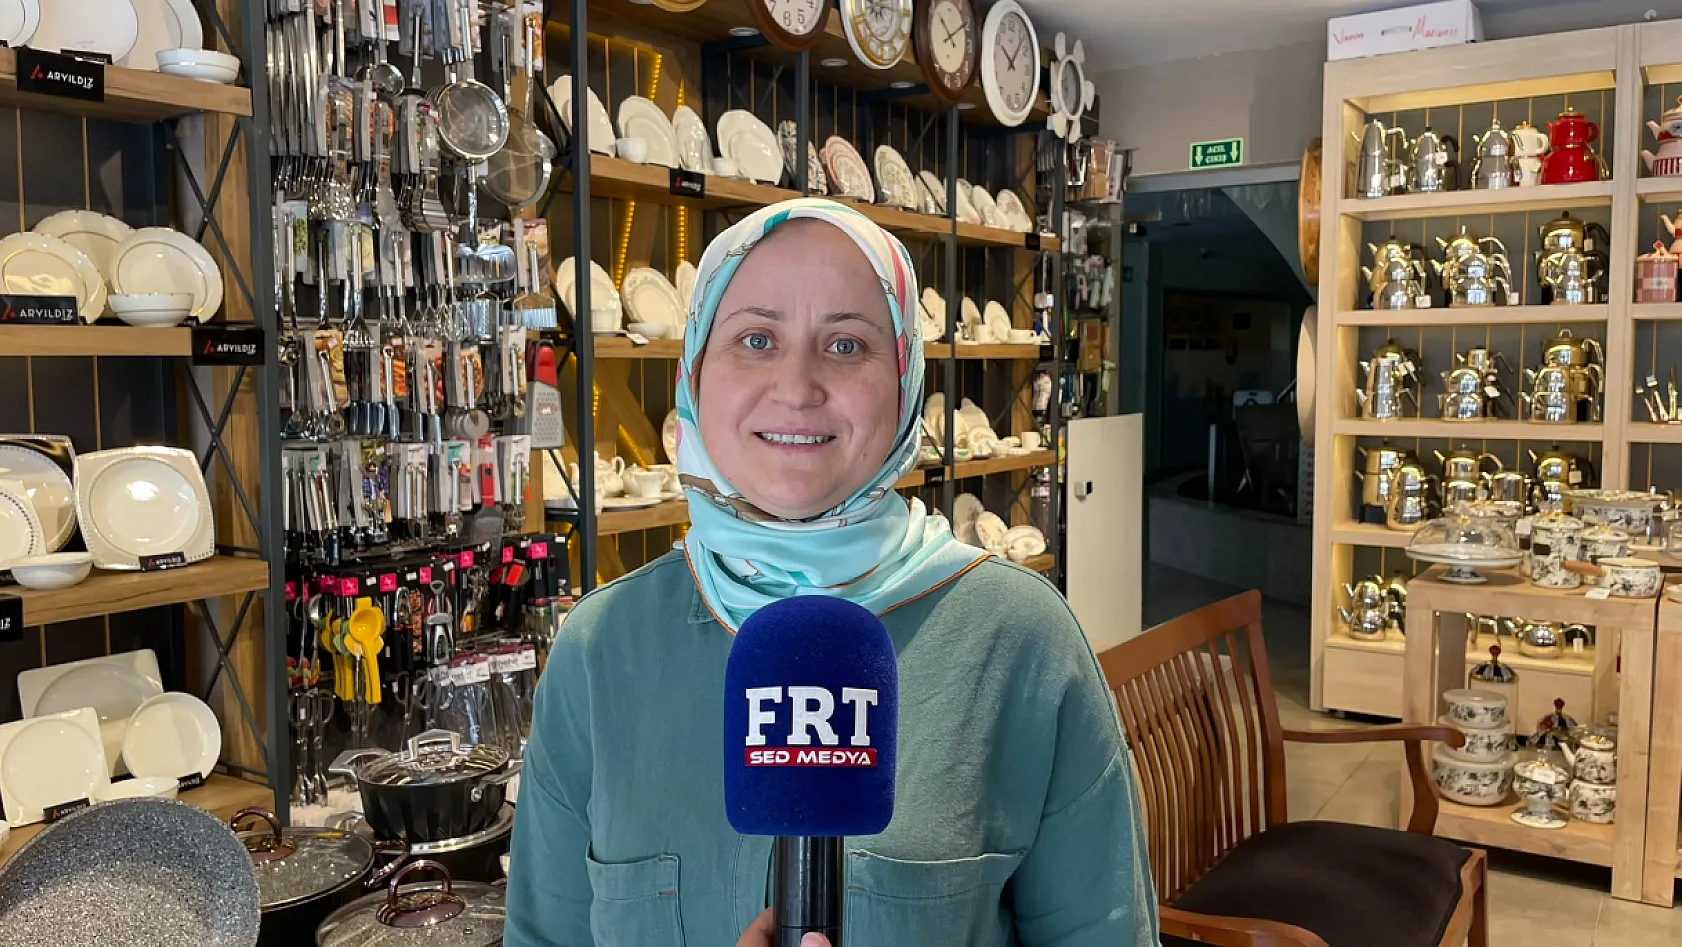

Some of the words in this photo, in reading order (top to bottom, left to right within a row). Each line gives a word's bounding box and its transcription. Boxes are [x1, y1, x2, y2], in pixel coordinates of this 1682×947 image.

[783, 11, 792, 26] 6
[797, 8, 805, 24] 5
[46, 70, 94, 88] ARYILDIZ
[20, 308, 73, 321] ARYILDIZ
[216, 344, 257, 356] ARYILDIZ
[745, 686, 878, 747] FRT
[750, 750, 790, 765] SED
[796, 750, 871, 765] MEDYA
